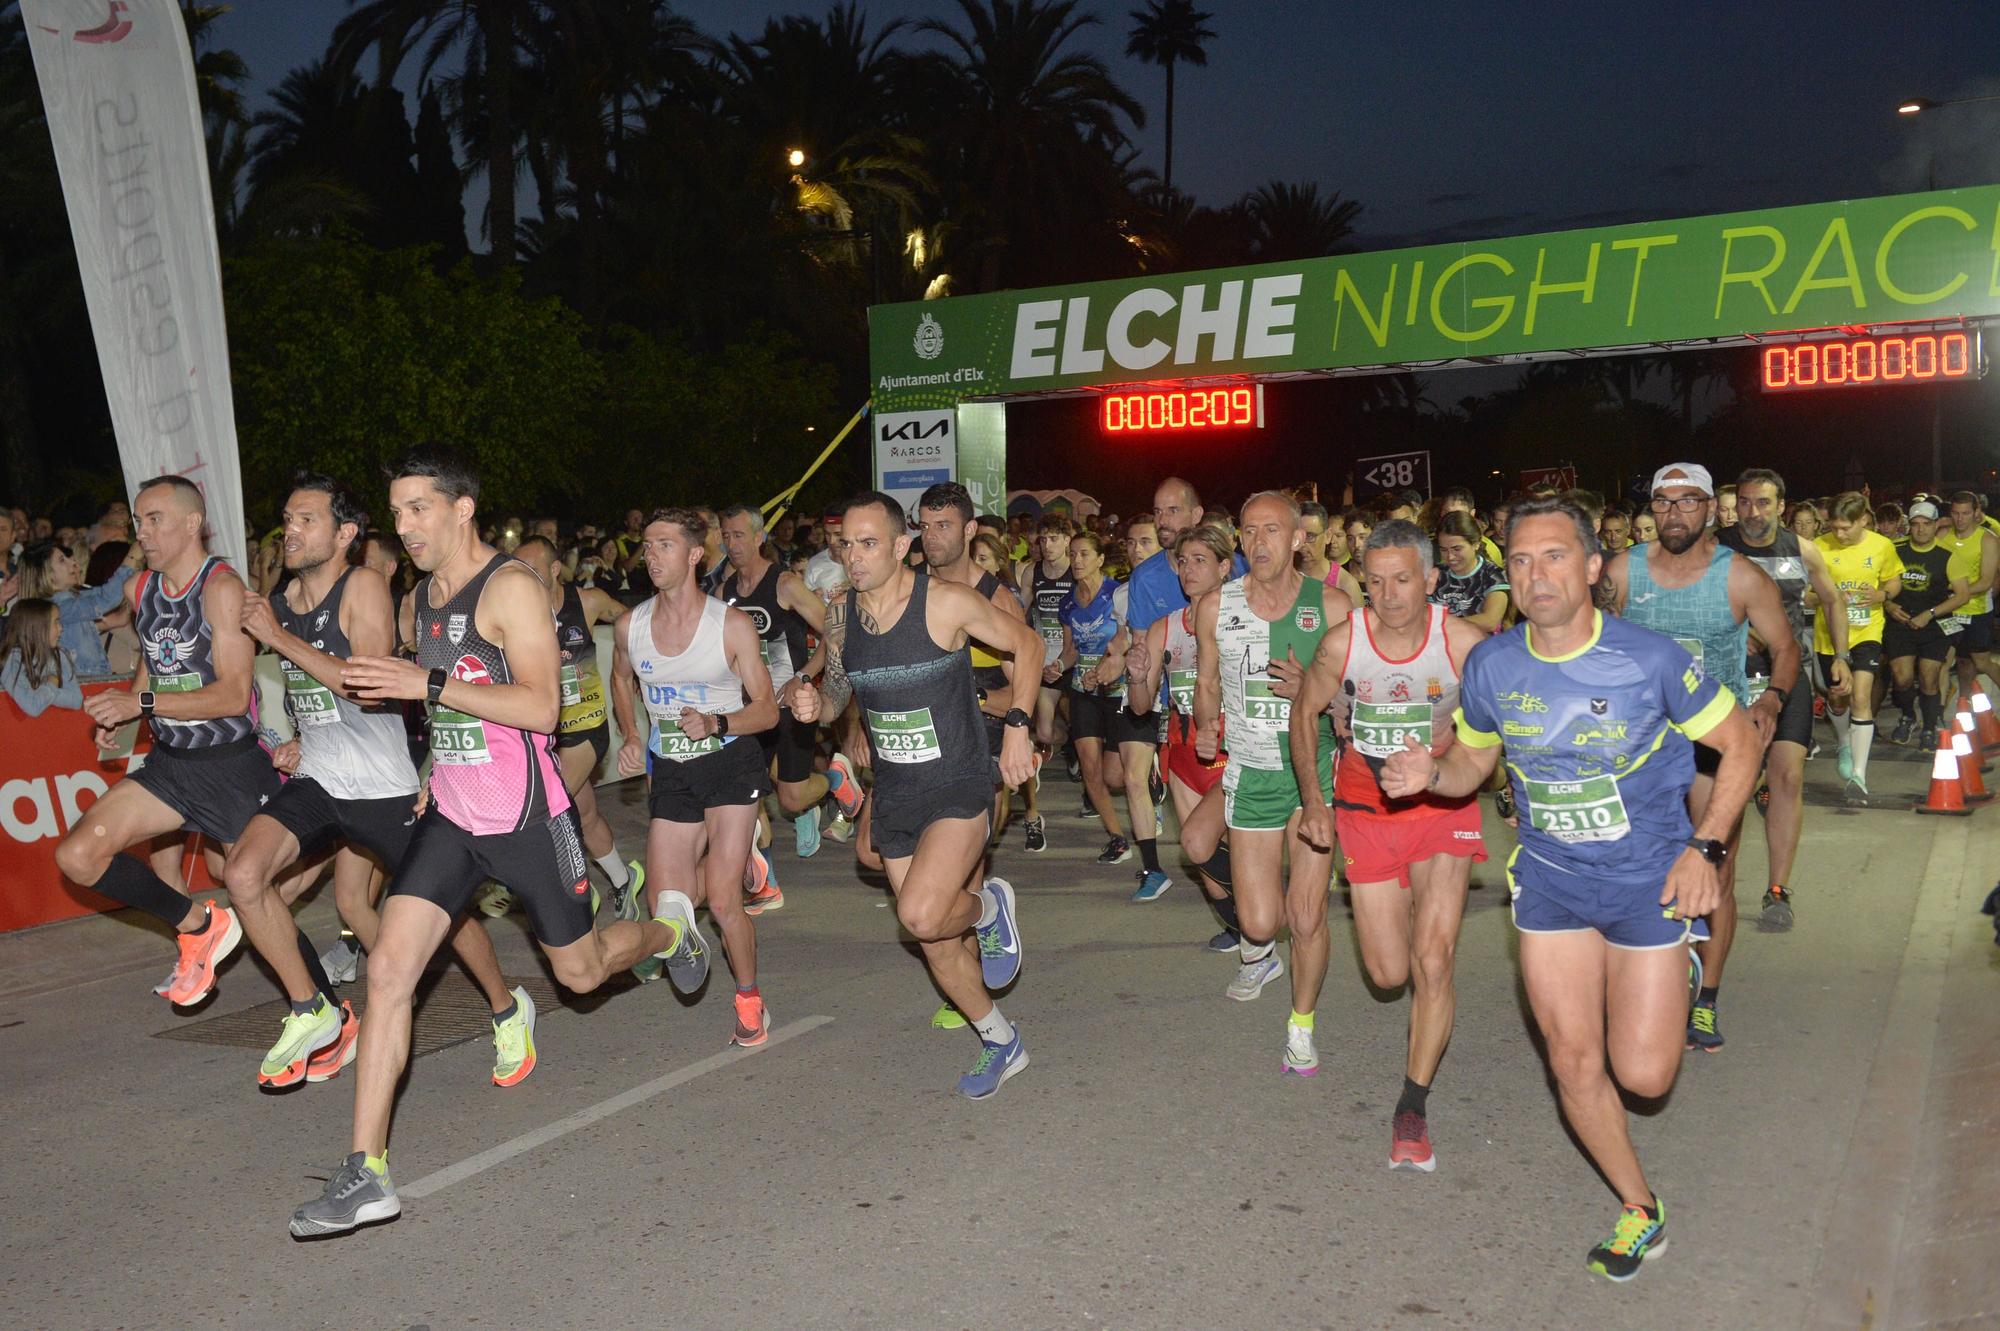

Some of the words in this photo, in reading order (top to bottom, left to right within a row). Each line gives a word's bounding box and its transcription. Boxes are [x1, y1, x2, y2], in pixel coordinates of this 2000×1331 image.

[1010, 273, 1303, 379] ELCHE
[1333, 234, 1678, 351] NIGHT
[879, 372, 950, 391] Ajuntament
[953, 367, 984, 382] d'Elx
[881, 418, 949, 441] KIA
[890, 446, 941, 457] MARCOS
[986, 458, 1000, 516] ACE
[1902, 572, 1927, 581] ELCHE
[155, 627, 181, 642] ESTESO
[1185, 671, 1197, 679] ELC
[882, 714, 907, 722] ELCHE
[1254, 702, 1291, 719] 218
[1375, 706, 1408, 715] ELCHE
[433, 729, 475, 749] 2516
[879, 733, 927, 750] 2282
[1363, 728, 1421, 745] 2186
[1548, 784, 1583, 795] ELCHE
[1542, 807, 1612, 831] 2510
